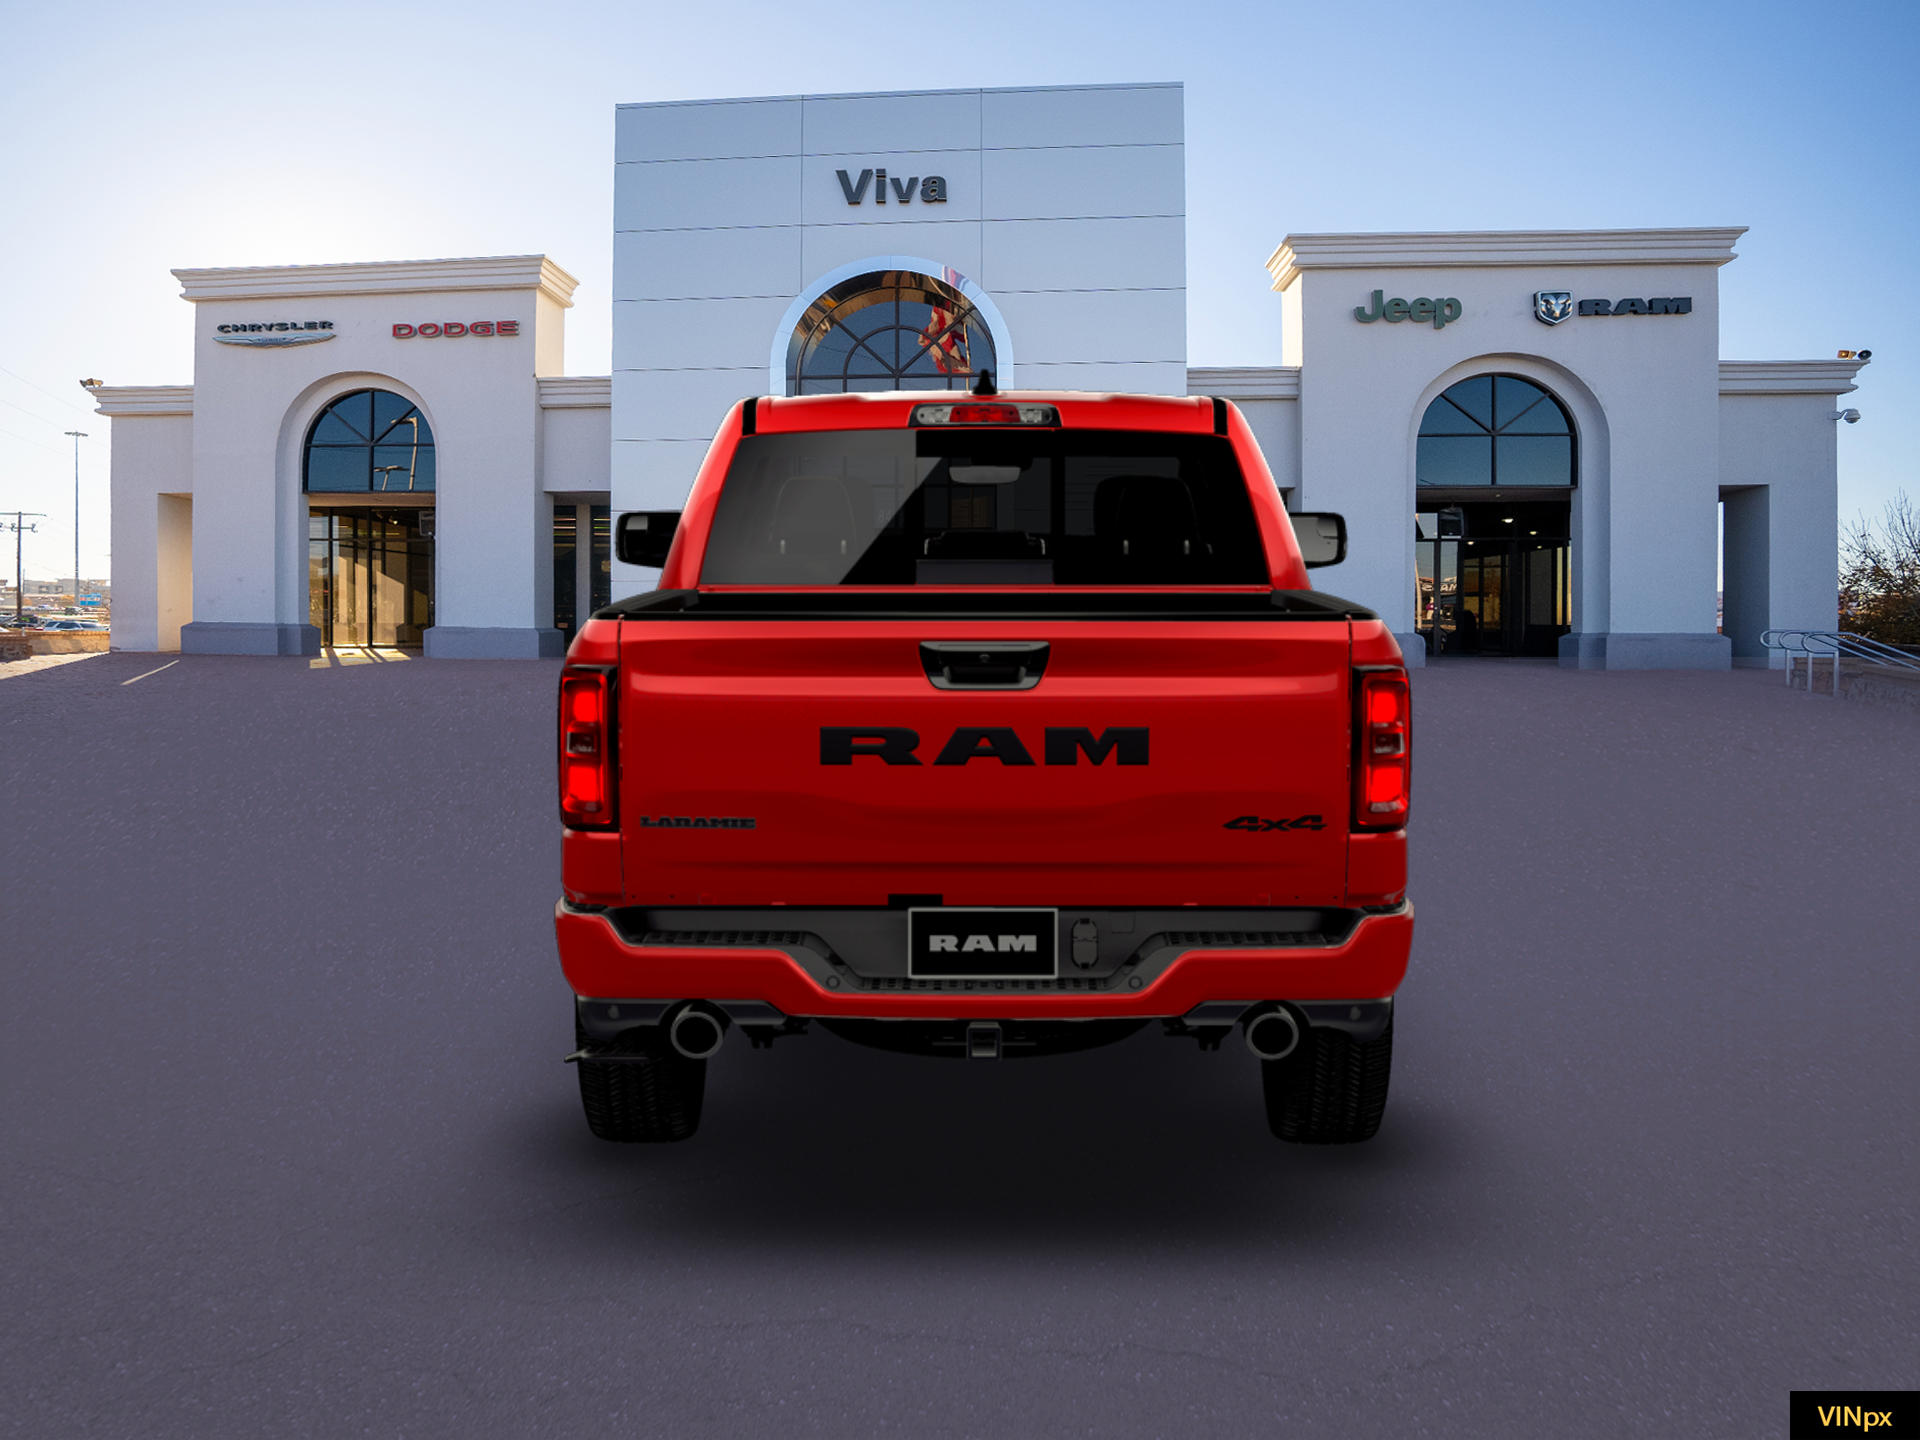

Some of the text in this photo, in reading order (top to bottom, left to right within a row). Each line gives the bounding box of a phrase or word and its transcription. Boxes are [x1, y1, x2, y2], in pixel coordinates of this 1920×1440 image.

[835, 168, 947, 205] Viva
[1354, 289, 1463, 329] Jeep
[1578, 297, 1692, 316] RAM
[217, 320, 334, 333] CHRYSLER
[392, 319, 520, 338] DODGE
[819, 726, 1150, 765] RAM
[640, 816, 756, 829] LARAMIE
[1221, 815, 1328, 832] 4x4
[929, 935, 1037, 952] RAM
